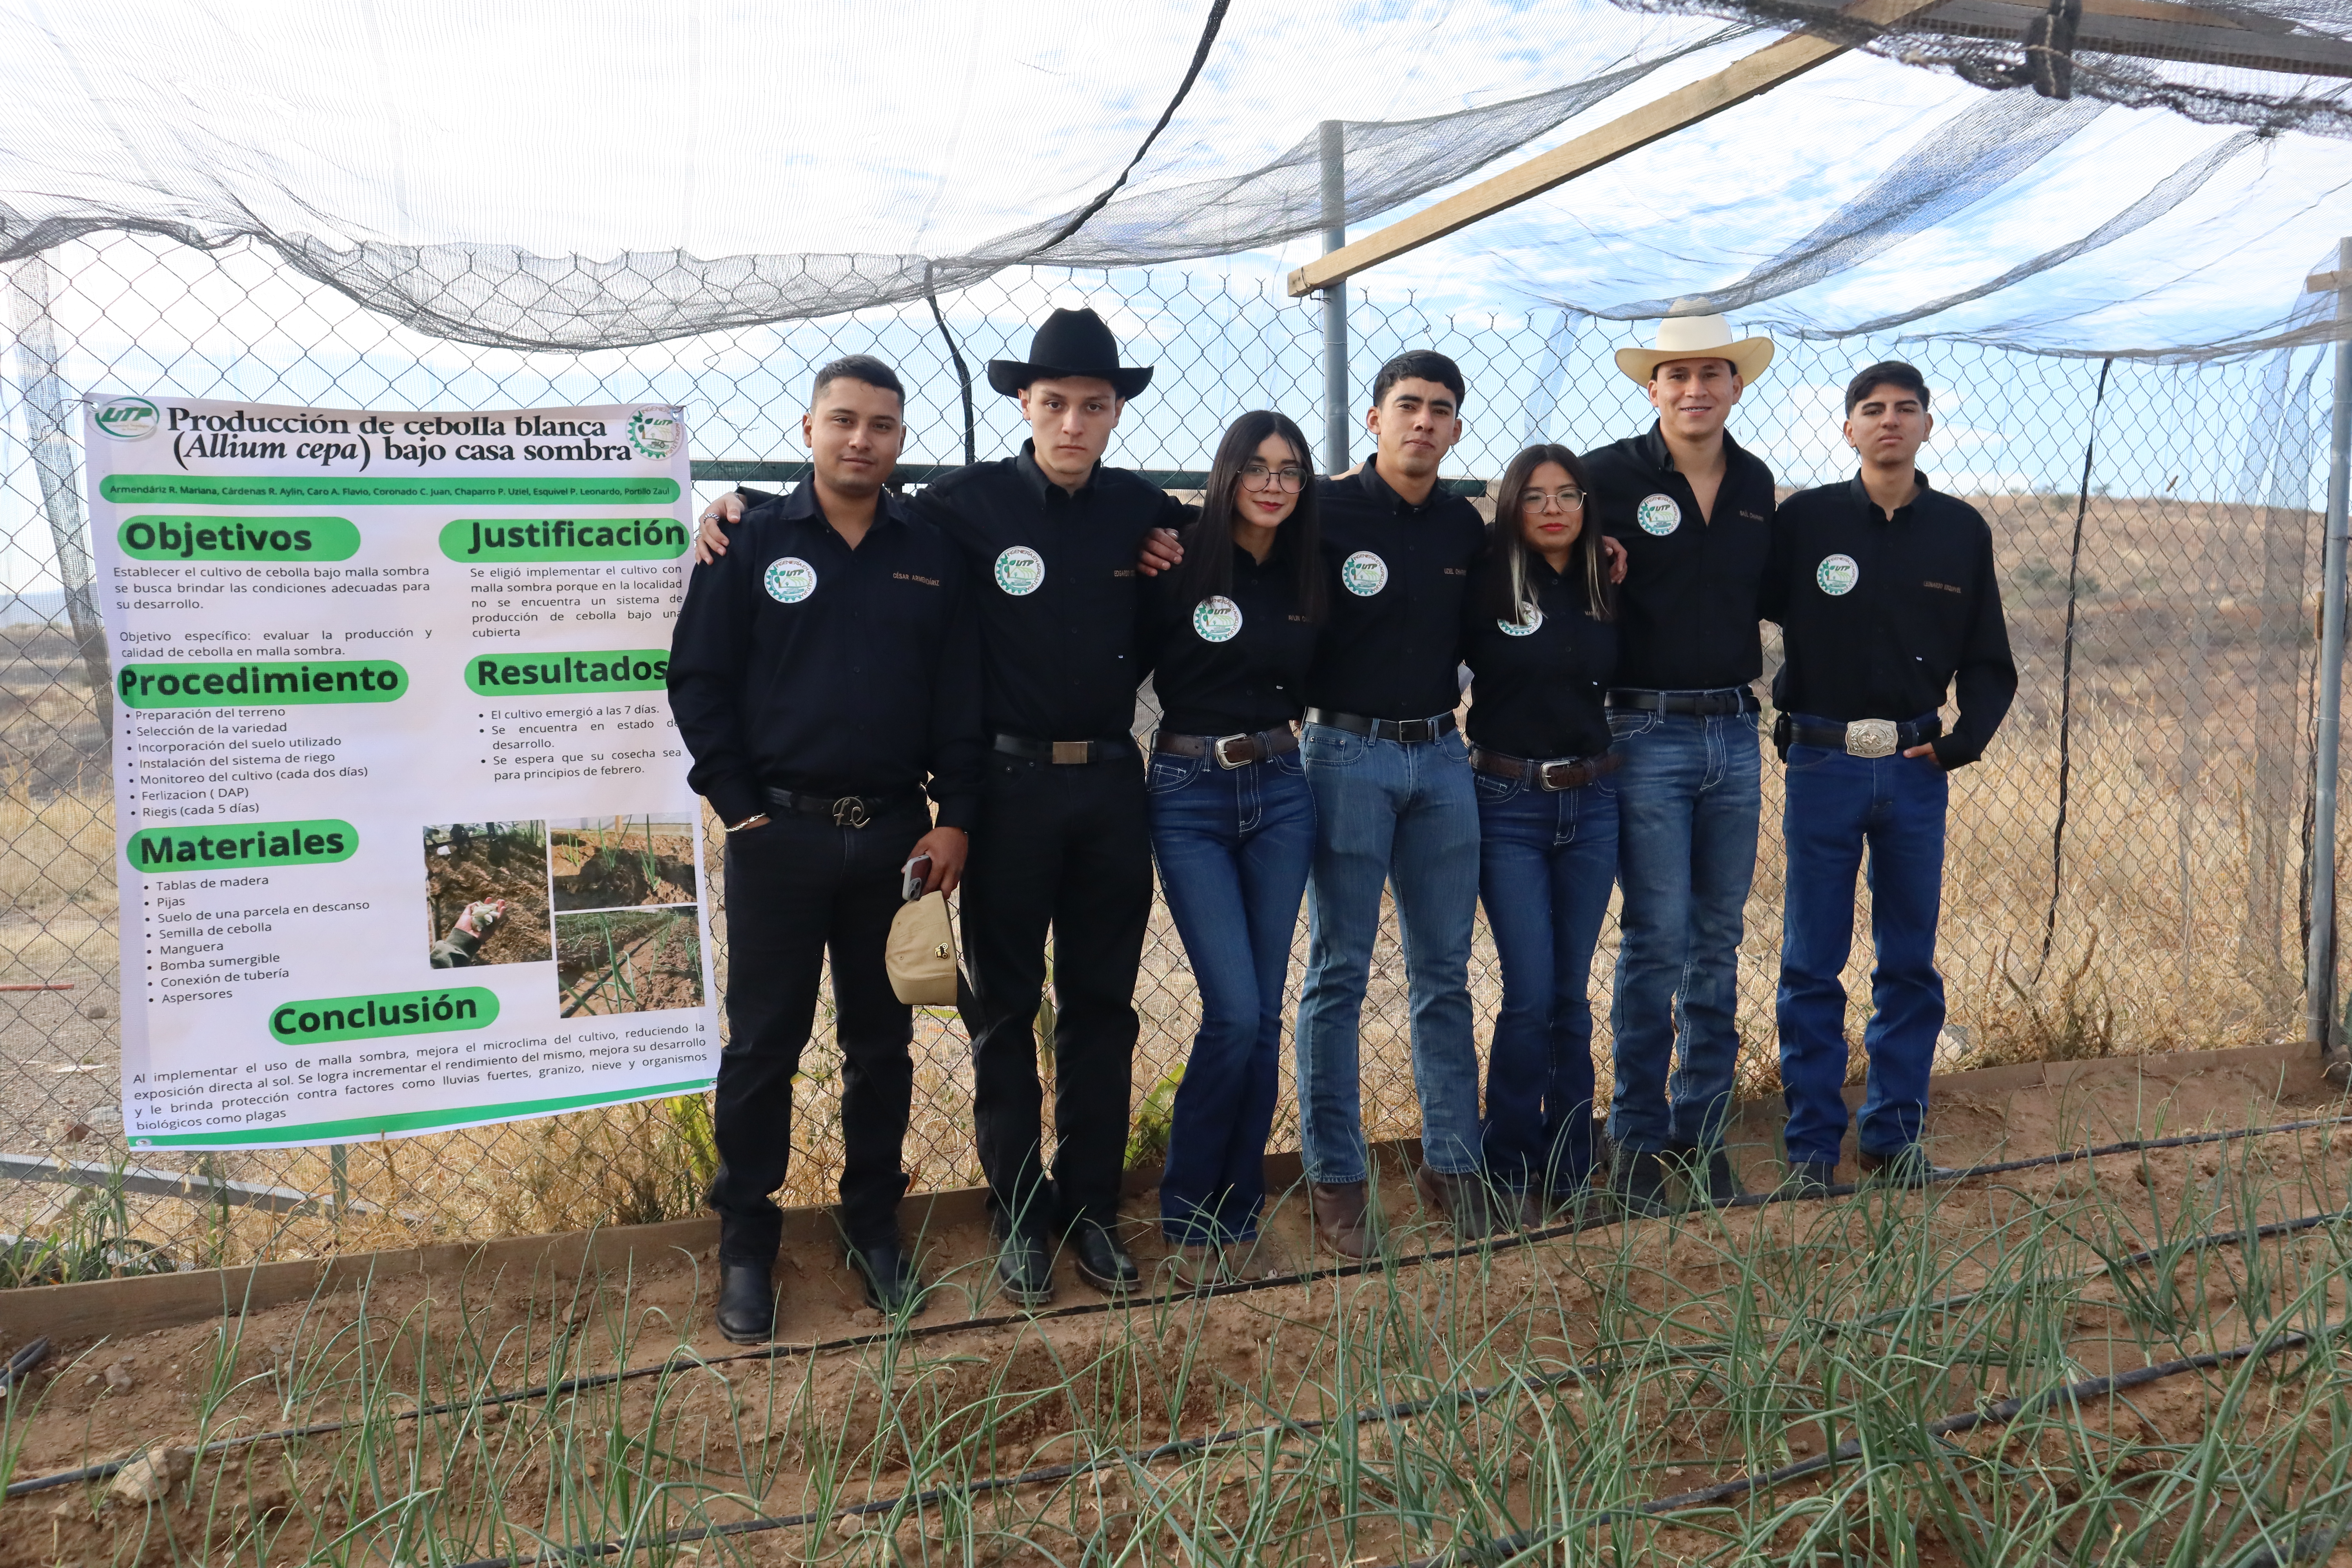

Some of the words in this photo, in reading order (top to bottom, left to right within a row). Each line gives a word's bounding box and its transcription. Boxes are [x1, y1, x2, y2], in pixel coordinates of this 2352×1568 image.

[100, 407, 152, 422] UTP
[167, 408, 350, 434] Producción
[359, 416, 394, 434] de
[404, 417, 505, 436] cebolla
[514, 415, 607, 437] blanca
[174, 431, 287, 470] (Allium
[296, 434, 370, 472] cepa)
[385, 436, 446, 467] bajo
[456, 445, 515, 460] casa
[524, 438, 632, 461] sombra
[126, 521, 312, 558] Objetivos
[467, 520, 685, 554] Justificación
[114, 567, 180, 577] Establecer
[185, 567, 195, 577] el
[200, 567, 242, 577] cultivo
[246, 567, 261, 577] de
[266, 567, 309, 577] cebolla
[314, 568, 341, 580] bajo
[345, 567, 378, 577] malla
[383, 566, 429, 576] sombra
[470, 568, 484, 577] Se
[490, 567, 521, 579] eligió
[527, 567, 601, 579] implementar
[606, 566, 615, 575] el
[621, 565, 657, 575] cultivo
[893, 571, 909, 580] CÉSAR
[134, 599, 203, 609] desarrollo.
[478, 655, 668, 686] Resultados
[121, 666, 398, 696] Procedimiento
[136, 709, 211, 722] Preparación
[216, 708, 234, 718] del
[238, 709, 285, 717] terreno
[492, 710, 501, 719] El
[505, 710, 542, 719] cultivo
[546, 707, 593, 719] emergió
[606, 706, 621, 715] las
[624, 706, 631, 714] 7
[634, 704, 659, 714] días.
[138, 740, 225, 754] Incorporación
[229, 739, 247, 750] del
[252, 738, 285, 749] suelo
[289, 736, 341, 747] utilizado
[494, 756, 507, 765] Se
[515, 756, 554, 766] espera
[562, 754, 583, 764] que
[612, 749, 655, 760] cosecha
[141, 775, 205, 784] Monitoreo
[209, 772, 227, 782] del
[232, 771, 272, 781] cultivo
[276, 769, 309, 781] (cada
[313, 768, 335, 778] dos
[339, 767, 368, 777] días)
[494, 772, 520, 782] para
[524, 768, 580, 781] principios
[583, 767, 597, 776] de
[600, 766, 644, 775] febrero.
[142, 791, 206, 800] Ferlizacion
[141, 828, 344, 864] Materiales
[156, 880, 196, 891] Tablas
[200, 878, 216, 888] de
[220, 876, 269, 887] madera
[157, 897, 185, 909] Pijas
[158, 912, 192, 923] Suelo
[196, 911, 212, 920] de
[216, 911, 240, 919] una
[244, 906, 289, 920] parcela
[312, 902, 370, 913] descanso
[160, 943, 223, 956] Manguera
[161, 959, 205, 971] Bomba
[209, 953, 280, 967] sumergible
[162, 991, 232, 1005] Aspersores
[274, 994, 476, 1035] Conclusión
[133, 1073, 145, 1084] Al
[154, 1067, 238, 1083] implementar
[246, 1063, 256, 1073] el
[265, 1062, 287, 1071] uso
[295, 1058, 310, 1068] de
[319, 1054, 352, 1066] malla
[359, 1050, 409, 1062] sombra,
[417, 1047, 458, 1058] mejora
[466, 1042, 475, 1052] el
[484, 1038, 547, 1051] microclima
[554, 1034, 571, 1044] del
[579, 1032, 618, 1042] cultivo,
[626, 1024, 688, 1038] reduciendo
[695, 1023, 704, 1032] la
[136, 1119, 202, 1130] biológicos
[206, 1115, 241, 1125] como
[246, 1110, 286, 1123] plagas
